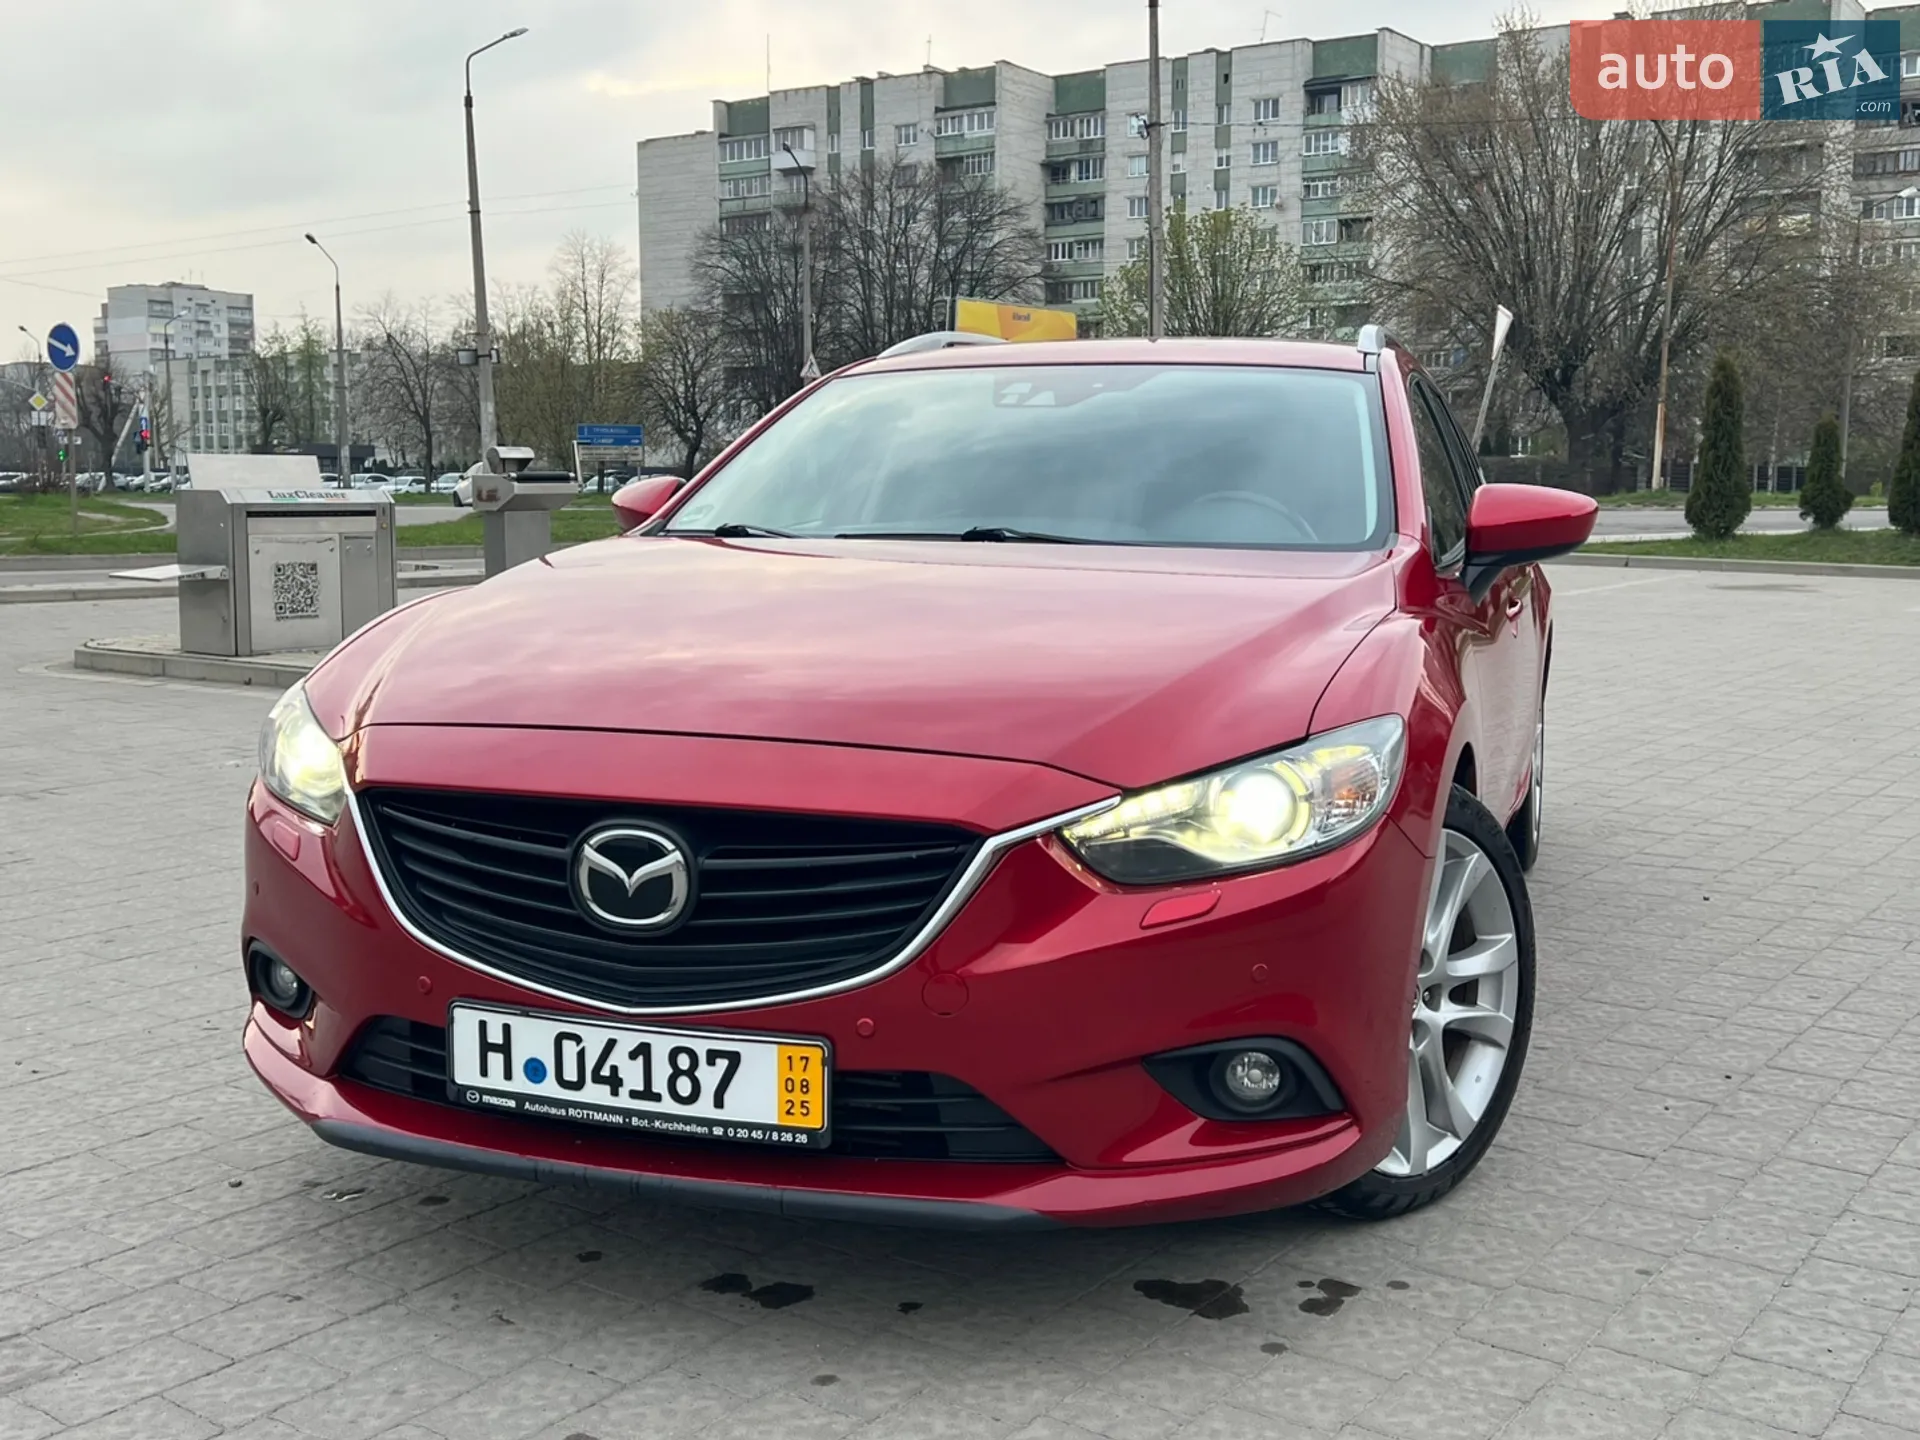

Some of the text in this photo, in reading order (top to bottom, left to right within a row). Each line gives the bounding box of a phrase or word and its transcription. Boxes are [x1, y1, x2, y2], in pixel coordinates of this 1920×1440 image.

[267, 490, 347, 499] LuxCleaner
[478, 1019, 742, 1109] H 04187
[787, 1055, 809, 1073] 17
[785, 1077, 810, 1095] 08
[524, 1101, 567, 1116] Autohaus
[568, 1108, 624, 1124] ROTTMANN
[785, 1099, 810, 1117] 25
